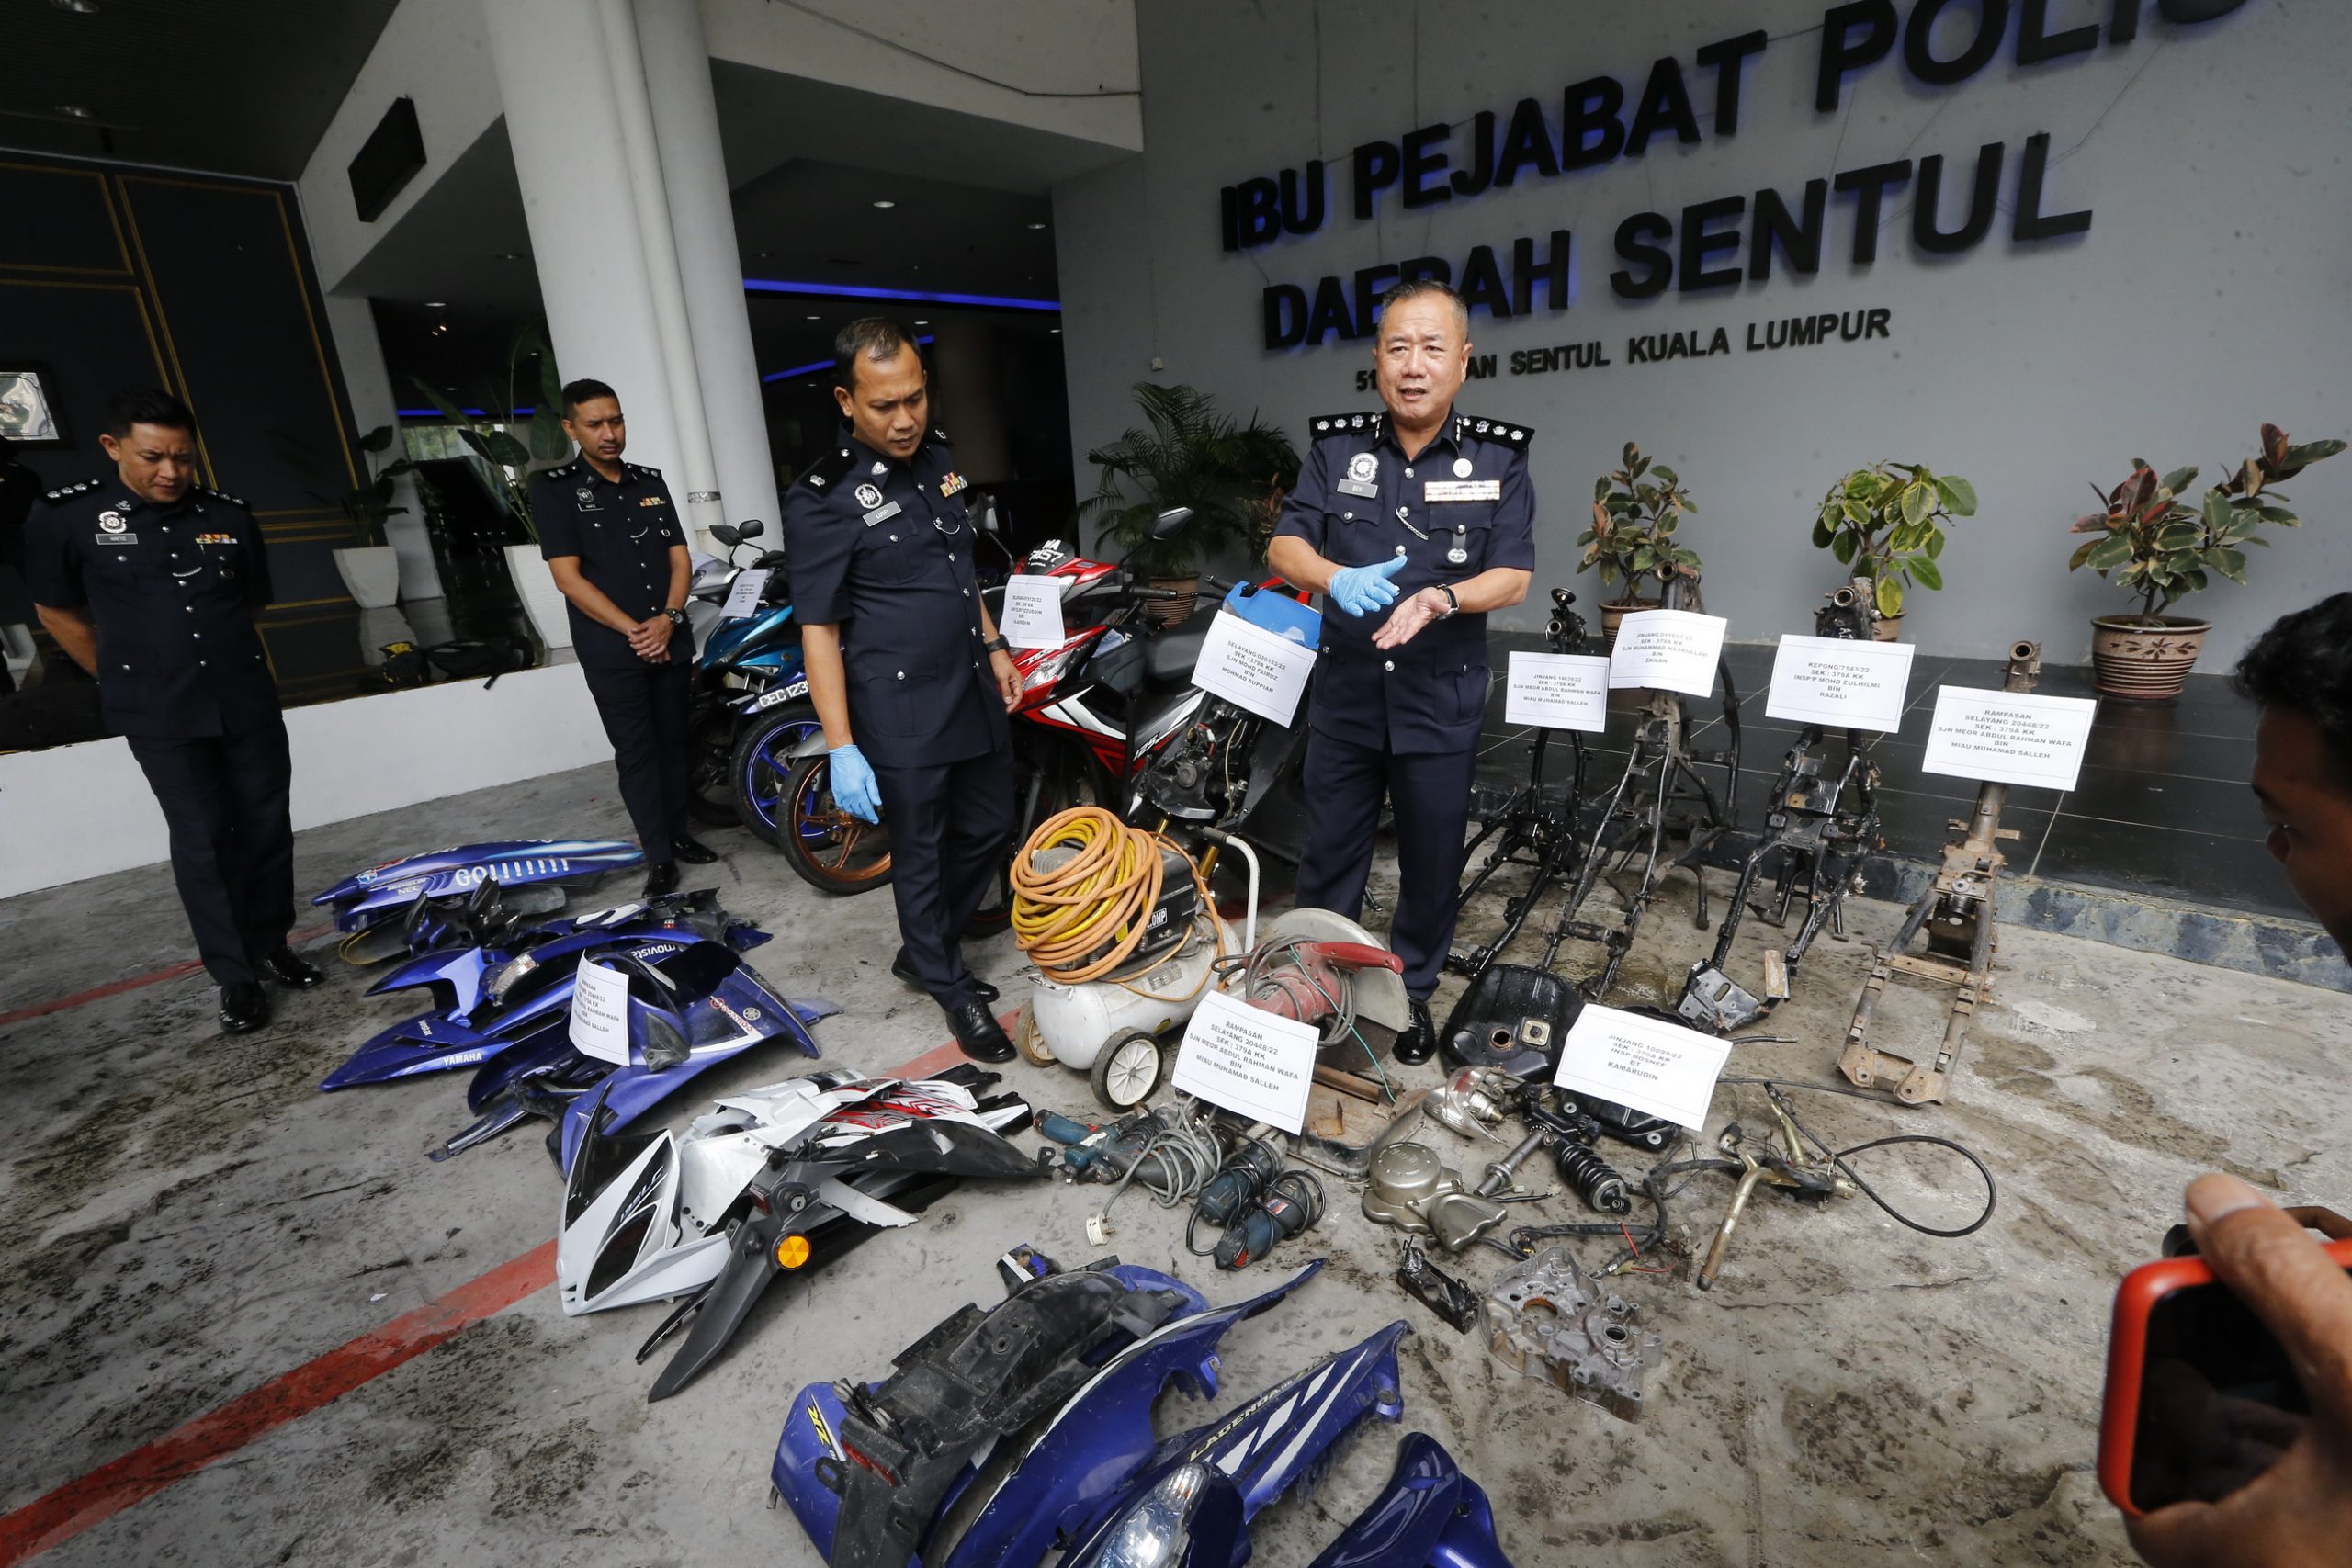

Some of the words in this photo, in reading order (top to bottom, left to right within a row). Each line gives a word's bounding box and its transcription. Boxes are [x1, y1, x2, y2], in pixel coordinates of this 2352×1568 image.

[1220, 160, 1325, 253] IBU
[1352, 29, 1768, 220] PEJABAT
[1263, 230, 1571, 350] DAEAH
[1609, 132, 2093, 299] SENTUL
[1510, 340, 1610, 376] SENTUL
[1627, 326, 1731, 365] KUALA
[1747, 308, 1891, 352] LUMPUR
[1234, 650, 1246, 660] SEK
[1227, 655, 1238, 663] SJN
[1238, 660, 1256, 671] MOHD
[1257, 668, 1279, 681] FAIRUZ
[1244, 670, 1255, 678] BIN
[1221, 667, 1247, 682] MOHMAD
[1248, 678, 1274, 694] SUPPIAN
[1843, 680, 1881, 689] ZULHILMI
[758, 688, 787, 708] CEC
[786, 680, 809, 698] 123
[1819, 692, 1847, 700] RAZALI
[1964, 715, 2009, 726] SELAYANG
[1984, 709, 2032, 720] RAMPASAN
[1955, 728, 1978, 736] MEOR
[1979, 731, 2007, 739] ABDUL
[2009, 735, 2046, 744] RAHMAN
[2048, 739, 2072, 747] WAFA
[1951, 741, 1972, 750] MIAU
[1973, 745, 2016, 755] MUHAMAD
[2018, 750, 2051, 759] SALLEH
[397, 885, 421, 895] NEC
[1210, 1023, 1243, 1043] SELAYANG
[1245, 1039, 1279, 1055] 20448/22
[1226, 1021, 1263, 1041] RAMPASAN
[1216, 1036, 1229, 1046] SEK
[1234, 1043, 1252, 1056] 379A
[1254, 1050, 1266, 1060] KK
[1608, 1034, 1644, 1049] JINJANG
[442, 1052, 482, 1066] YAMAHA
[1189, 1032, 1201, 1043] SJN
[1201, 1037, 1218, 1051] MEOR
[1219, 1045, 1241, 1061] ABDUL
[1243, 1056, 1275, 1072] RAHMAN
[1277, 1067, 1299, 1080] WAFA
[1611, 1047, 1631, 1057] INSP
[1633, 1054, 1668, 1067] ROSNEE
[1612, 1042, 1628, 1051] SEK
[1658, 1055, 1671, 1063] KK
[1196, 1054, 1212, 1066] MIAU
[1213, 1061, 1249, 1081] MUHAMAD
[1250, 1076, 1279, 1091] SALLEH
[1229, 1060, 1242, 1069] BIN
[1607, 1061, 1658, 1081] KAMARUDIN
[1630, 1059, 1641, 1067] BT
[1190, 1389, 1280, 1463] LAGENDA
